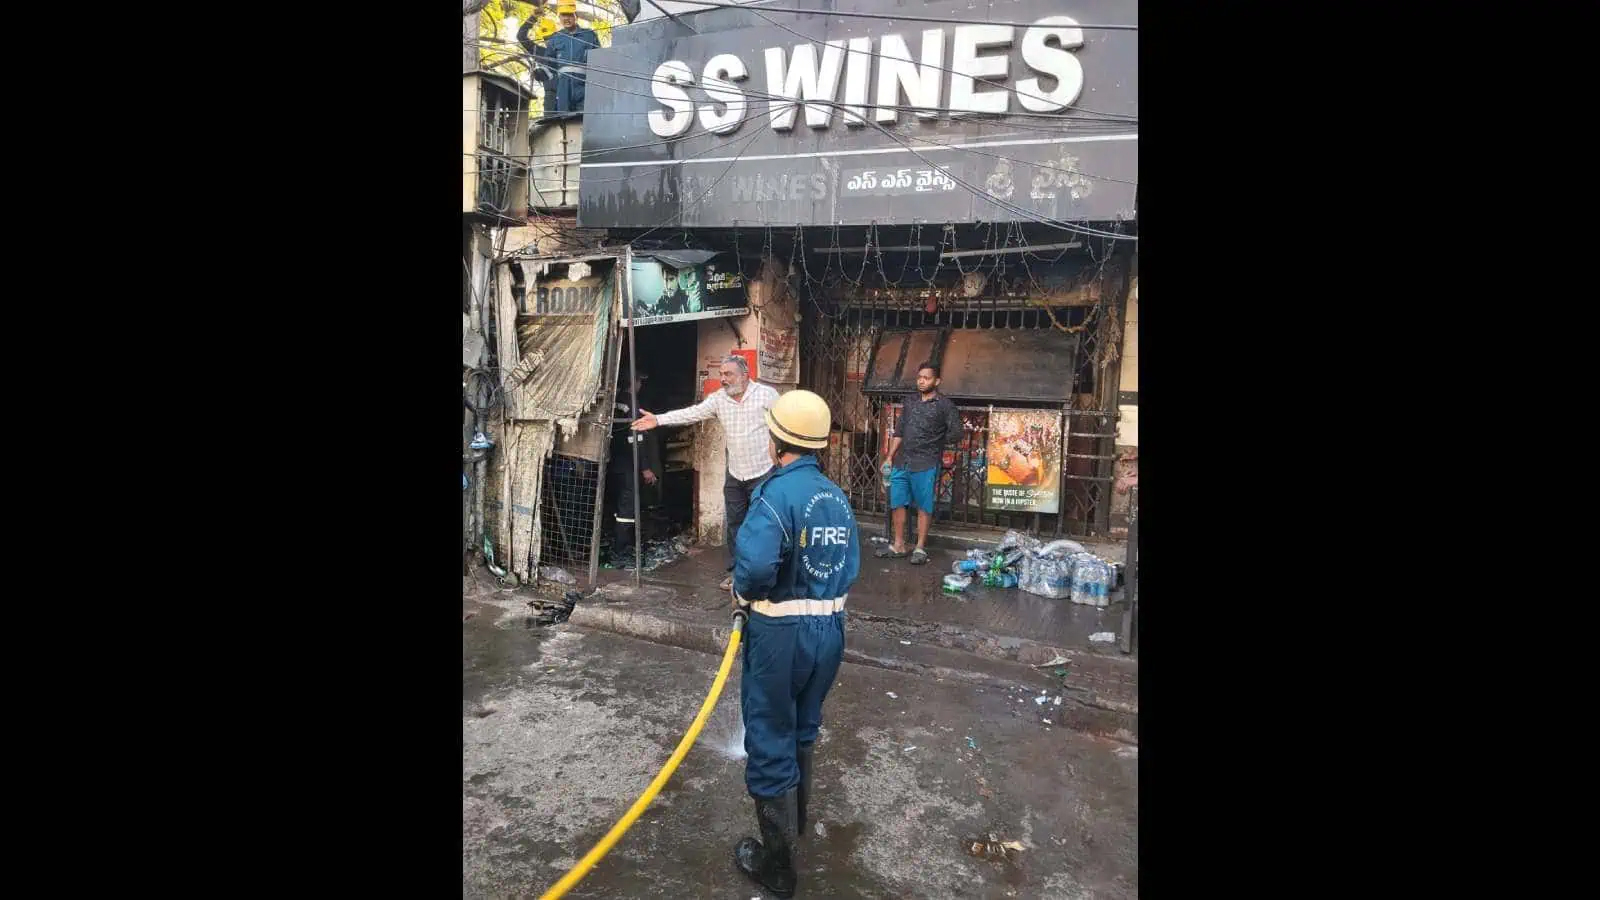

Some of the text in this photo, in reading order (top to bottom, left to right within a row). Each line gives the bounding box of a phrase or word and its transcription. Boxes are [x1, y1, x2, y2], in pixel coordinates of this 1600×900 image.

[648, 16, 1085, 138] SS WINES
[811, 526, 847, 546] FIRE
